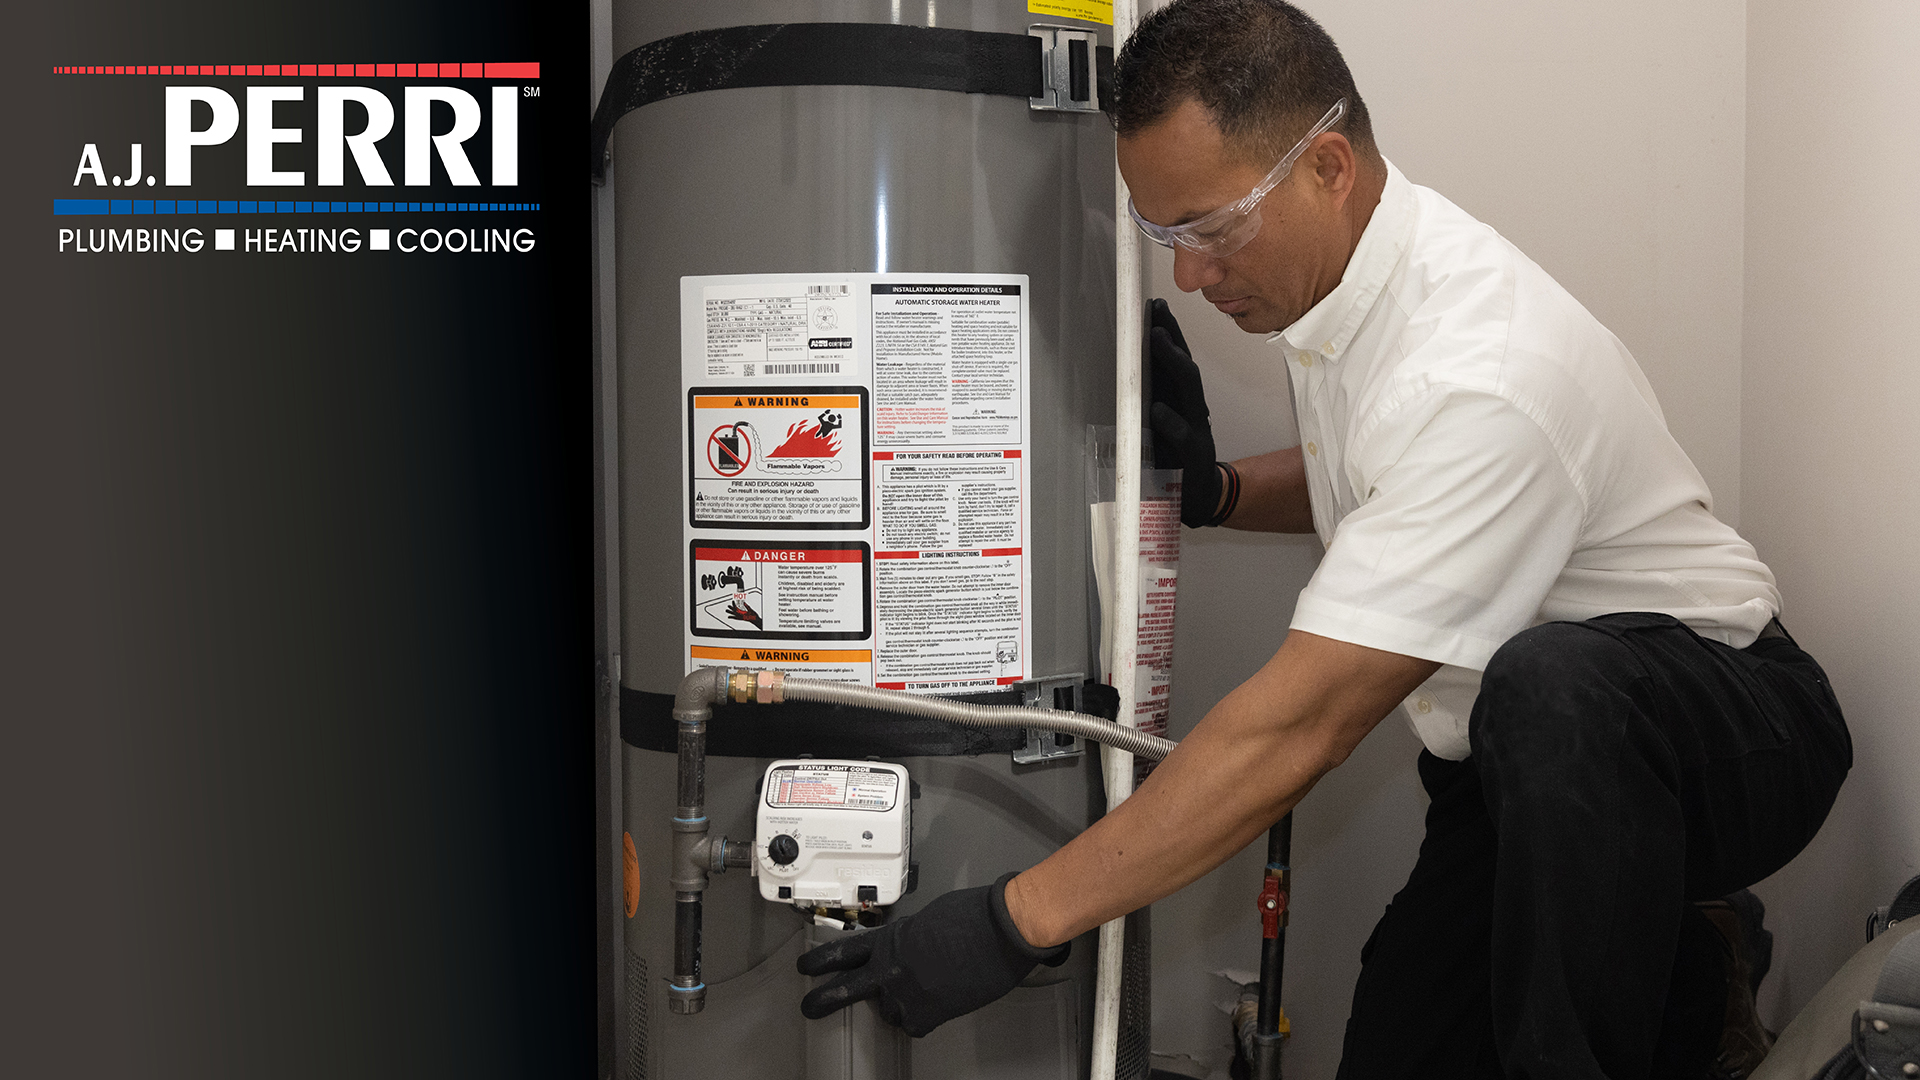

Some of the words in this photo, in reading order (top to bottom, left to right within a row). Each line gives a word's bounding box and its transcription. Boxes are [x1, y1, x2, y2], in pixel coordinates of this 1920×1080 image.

[748, 397, 808, 405] WARNING
[754, 551, 804, 560] DANGER
[756, 652, 808, 660] WARNING
[837, 864, 890, 877] resideo
